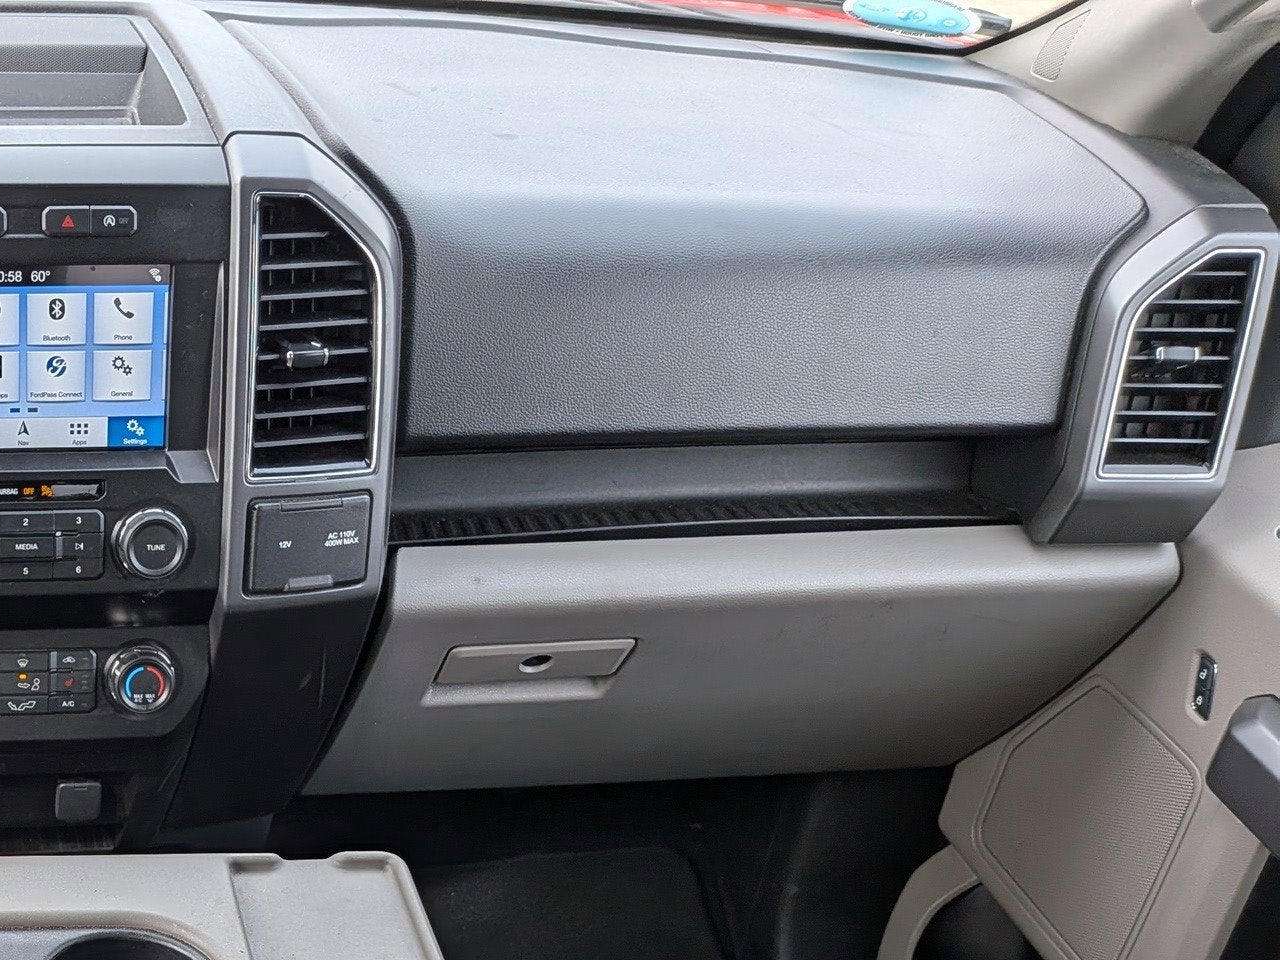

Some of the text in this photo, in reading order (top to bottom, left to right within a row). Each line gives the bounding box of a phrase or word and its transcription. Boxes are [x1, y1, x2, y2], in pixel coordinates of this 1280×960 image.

[30, 270, 51, 282] 60°
[123, 438, 148, 446] Settings
[23, 487, 35, 495] OFF
[23, 518, 29, 526] 2
[328, 530, 356, 540] AC 110V
[278, 541, 292, 549] 12V
[324, 537, 359, 547] 400W MAX
[23, 567, 29, 575] 5
[75, 566, 82, 574] 6
